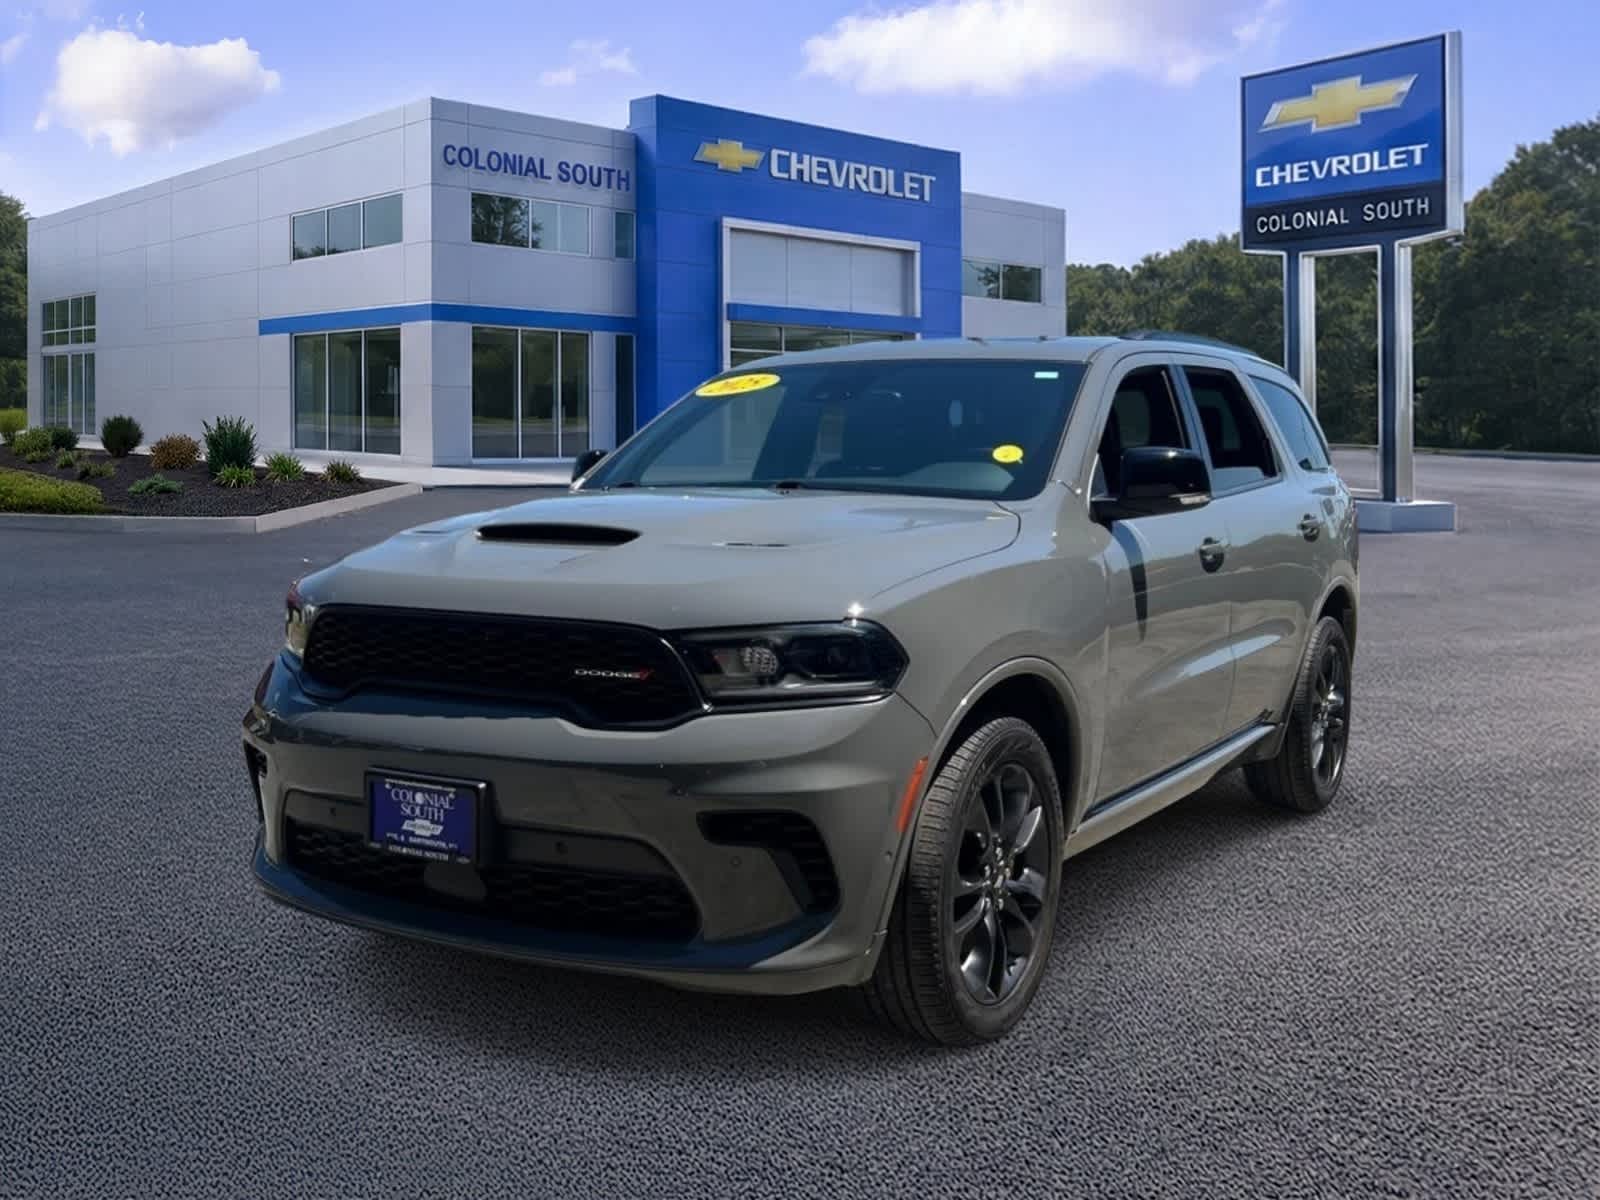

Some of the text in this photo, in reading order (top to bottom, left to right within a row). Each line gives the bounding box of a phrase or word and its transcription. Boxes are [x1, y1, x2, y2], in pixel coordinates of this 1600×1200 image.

[443, 144, 630, 192] COLONIAL SOUTH
[770, 148, 936, 202] CHEVROLET
[1255, 143, 1429, 187] CHEVROLET
[1256, 197, 1430, 233] COLONIAL SOUTH
[575, 669, 640, 679] DODGE
[391, 788, 454, 809] COLONIAL
[401, 803, 444, 821] SOUTH
